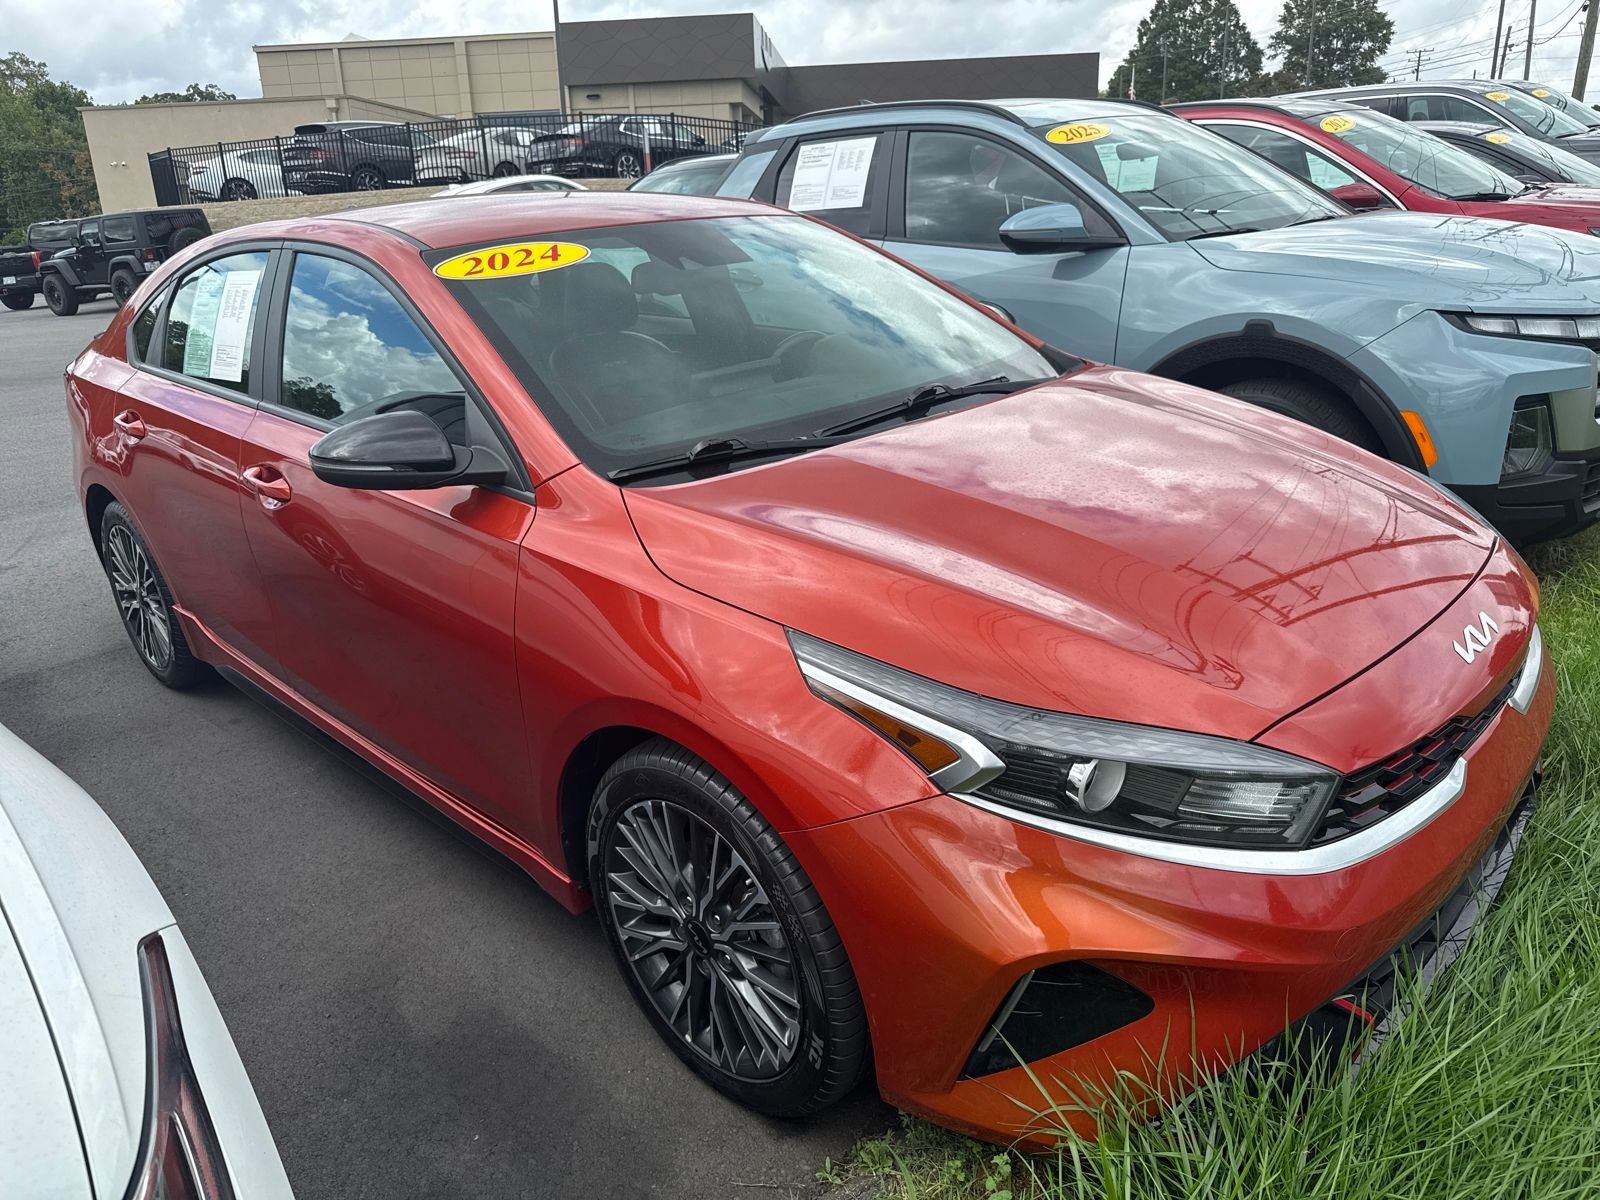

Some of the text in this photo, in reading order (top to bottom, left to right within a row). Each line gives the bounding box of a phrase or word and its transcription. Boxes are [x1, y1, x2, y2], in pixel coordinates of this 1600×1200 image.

[1058, 125, 1101, 142] 2025
[463, 244, 562, 277] 2024
[1452, 611, 1498, 664] KIA
